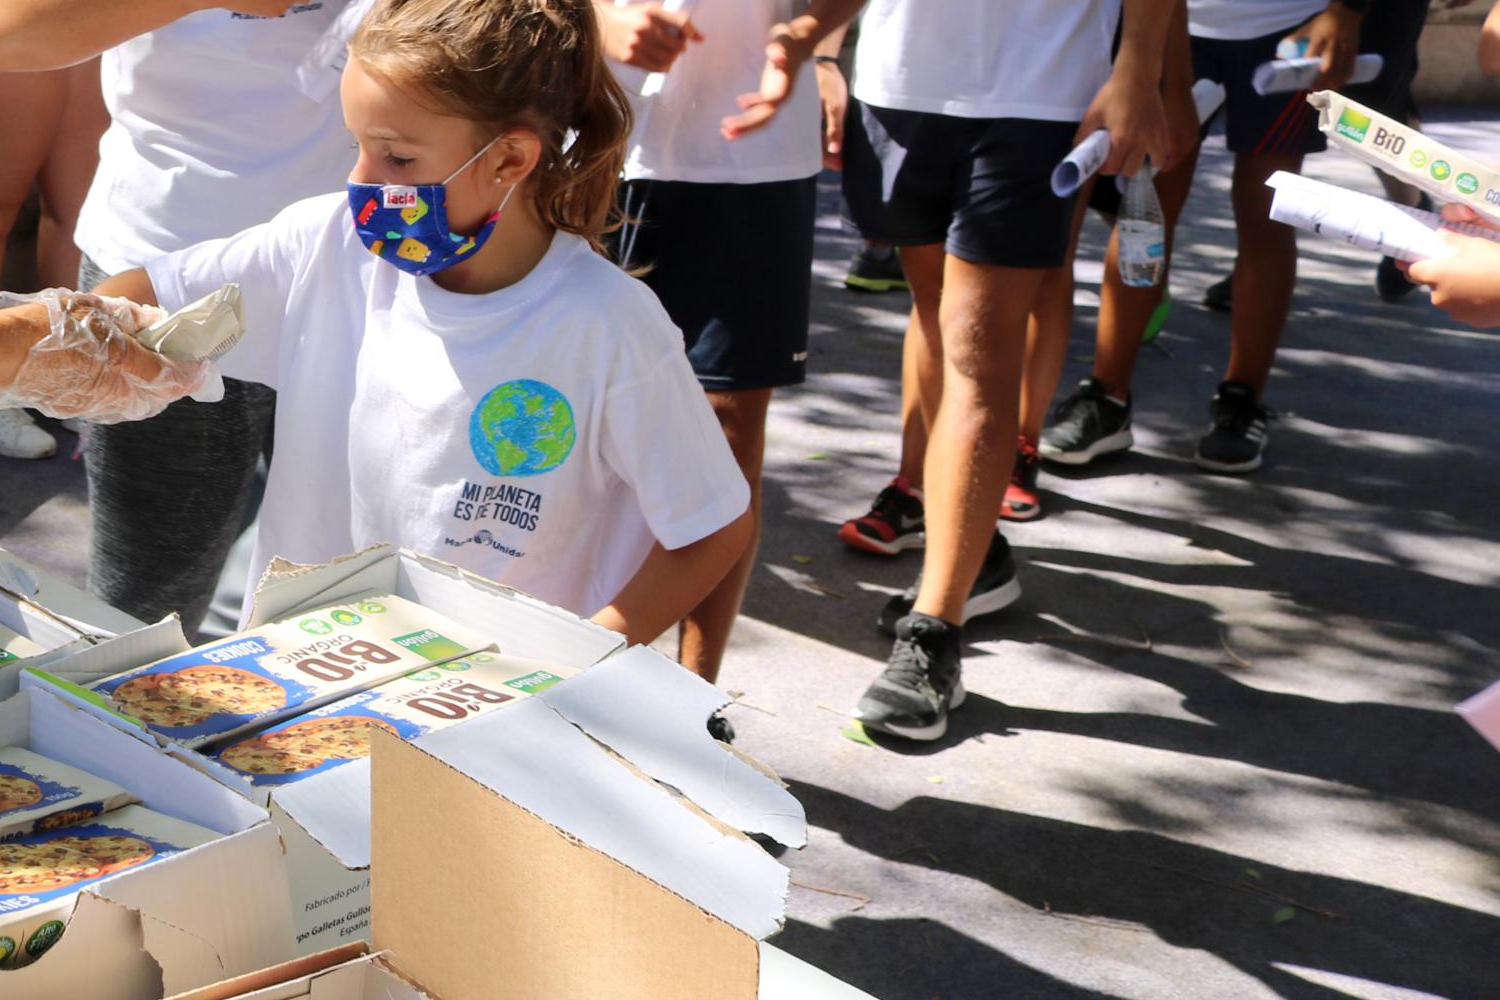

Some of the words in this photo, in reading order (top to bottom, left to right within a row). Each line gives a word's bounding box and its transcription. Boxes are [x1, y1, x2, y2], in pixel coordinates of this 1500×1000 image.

[461, 482, 482, 502] MI
[483, 484, 542, 513] PLANETA
[453, 501, 474, 521] ES
[492, 503, 540, 532] TODOS
[202, 639, 266, 663] COOKIES
[280, 634, 354, 664] ORGANIC
[305, 890, 345, 912] Fabricado
[346, 883, 361, 899] por
[312, 916, 345, 935] Galletas
[340, 920, 369, 937] España
